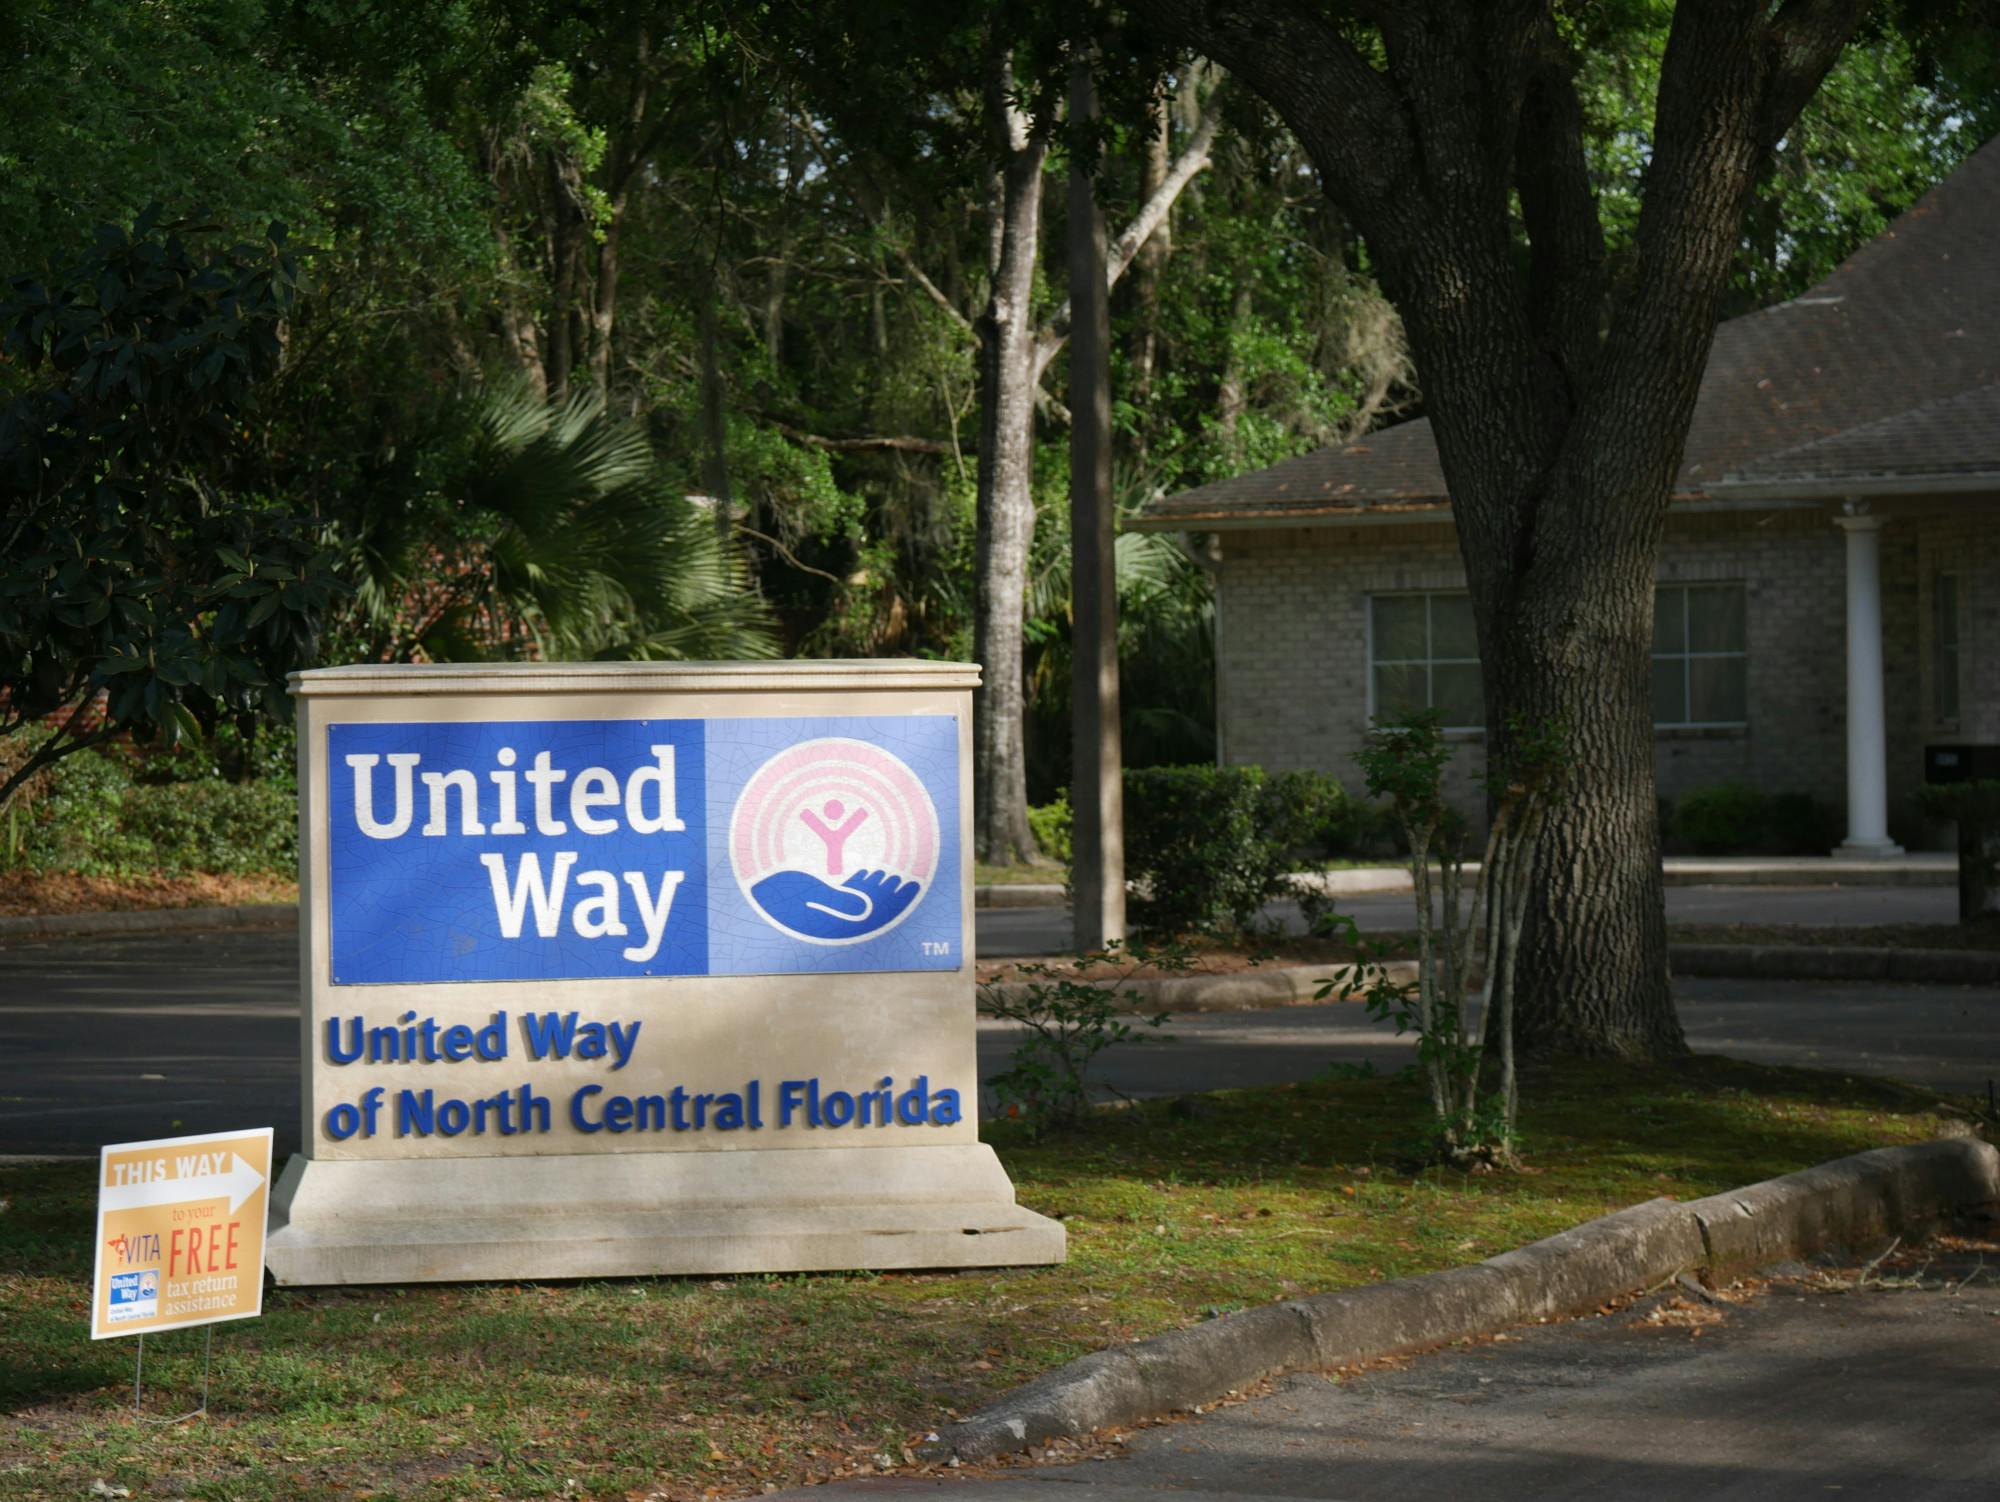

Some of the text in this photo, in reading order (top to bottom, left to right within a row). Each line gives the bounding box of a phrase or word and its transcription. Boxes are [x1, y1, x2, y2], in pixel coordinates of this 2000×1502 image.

[346, 744, 685, 839] United
[480, 851, 685, 962] Way
[921, 942, 950, 957] TM
[327, 1010, 641, 1070] United Way
[327, 1075, 962, 1140] of North Central Florida
[113, 1152, 227, 1186] THIS WAY
[172, 1206, 216, 1224] to your
[125, 1233, 161, 1264] VITA
[169, 1221, 240, 1278] FREE
[167, 1275, 238, 1298] tax return
[165, 1293, 237, 1316] assistance
